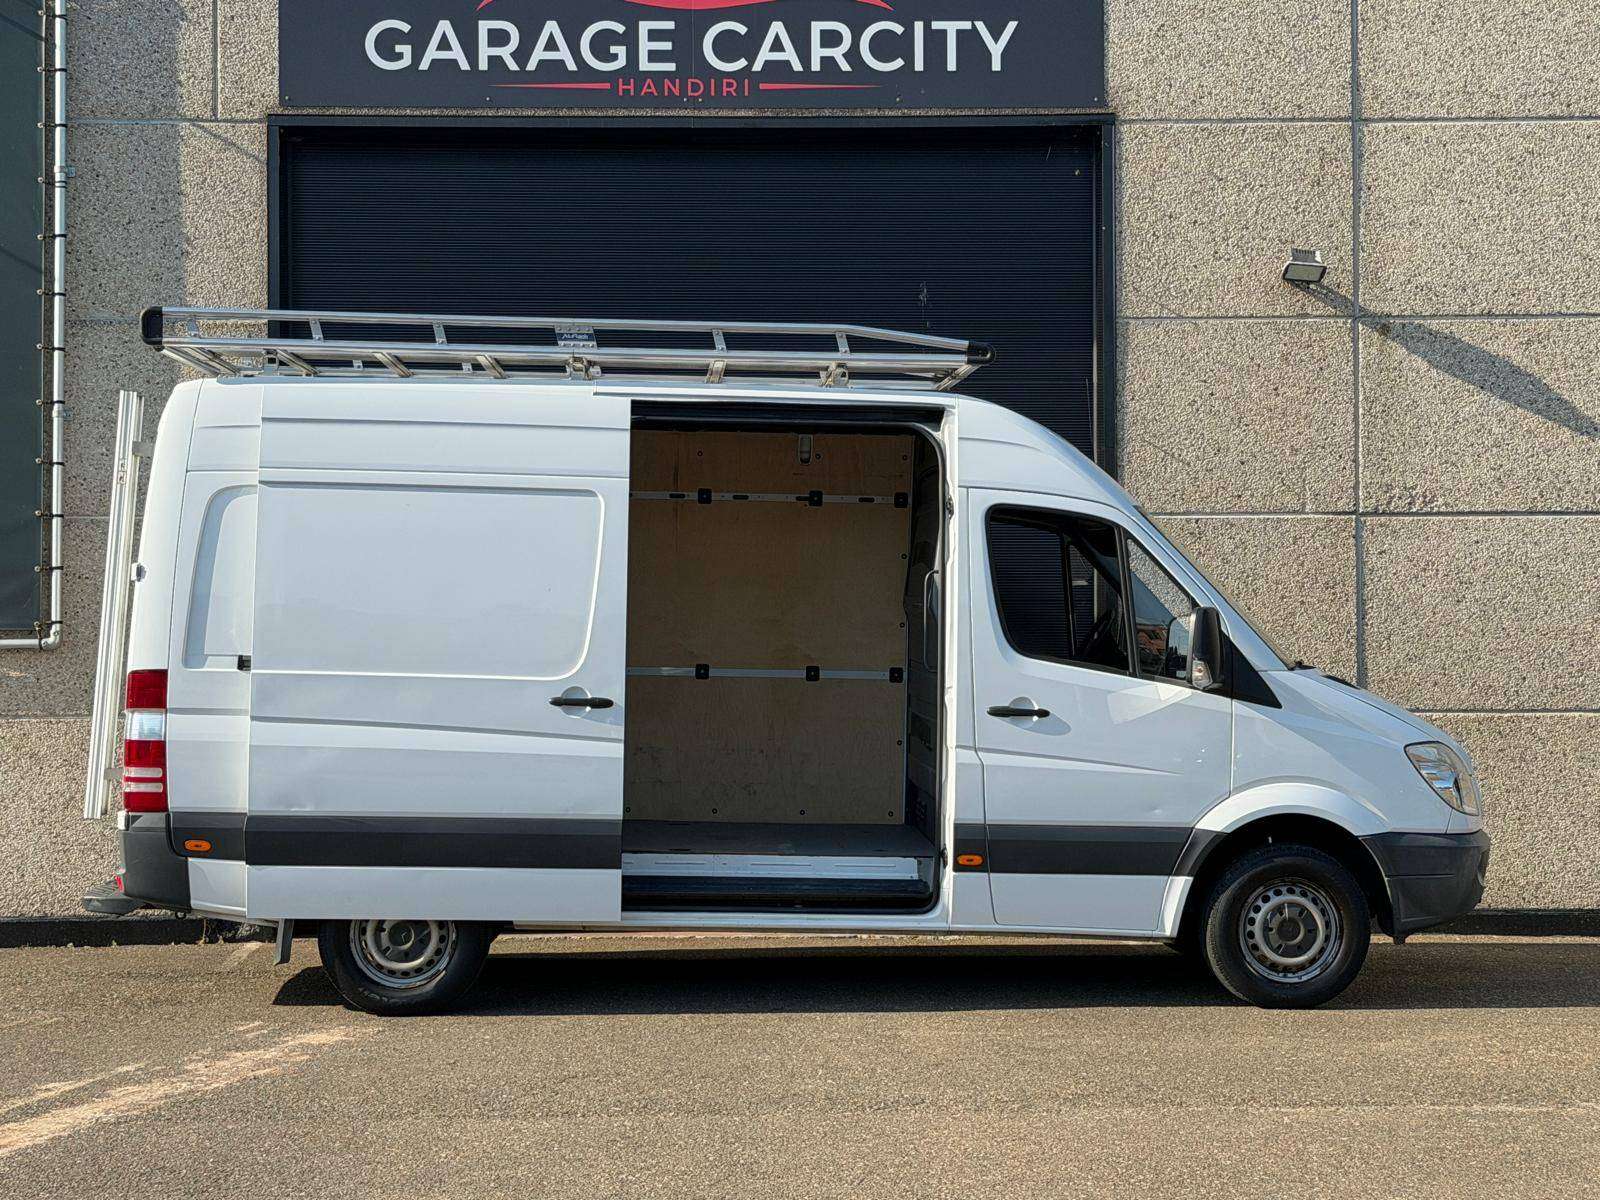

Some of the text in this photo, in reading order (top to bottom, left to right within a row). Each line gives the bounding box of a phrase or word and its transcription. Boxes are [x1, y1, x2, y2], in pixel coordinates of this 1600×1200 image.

[364, 19, 1019, 72] GARAGE CARCITY
[617, 78, 750, 97] HANDIRI
